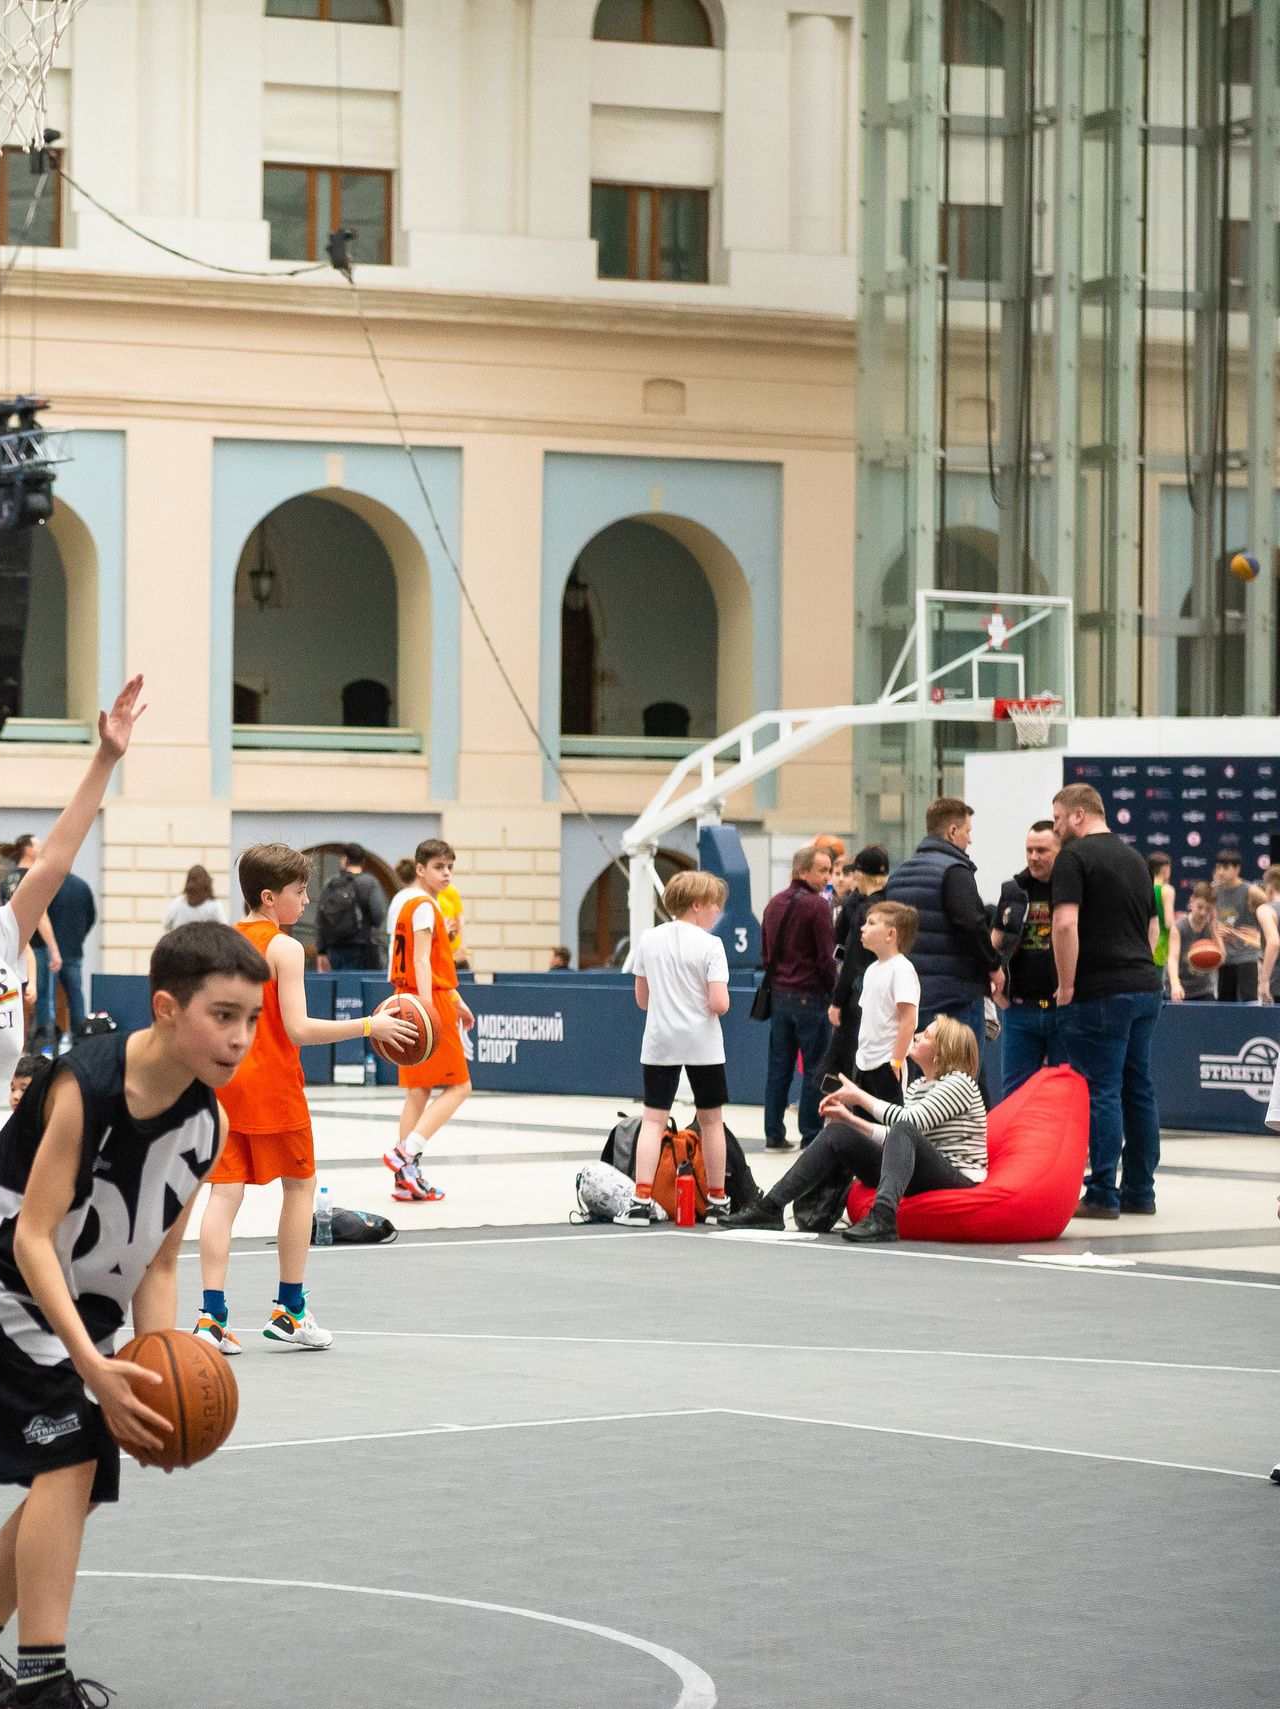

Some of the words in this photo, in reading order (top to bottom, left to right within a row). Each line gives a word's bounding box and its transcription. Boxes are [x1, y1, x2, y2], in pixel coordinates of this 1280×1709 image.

[734, 926, 749, 954] 3
[477, 1011, 564, 1042] МОСКОВСКИЙ
[477, 1039, 519, 1064] СПОРТ
[1200, 1063, 1276, 1083] STREETB
